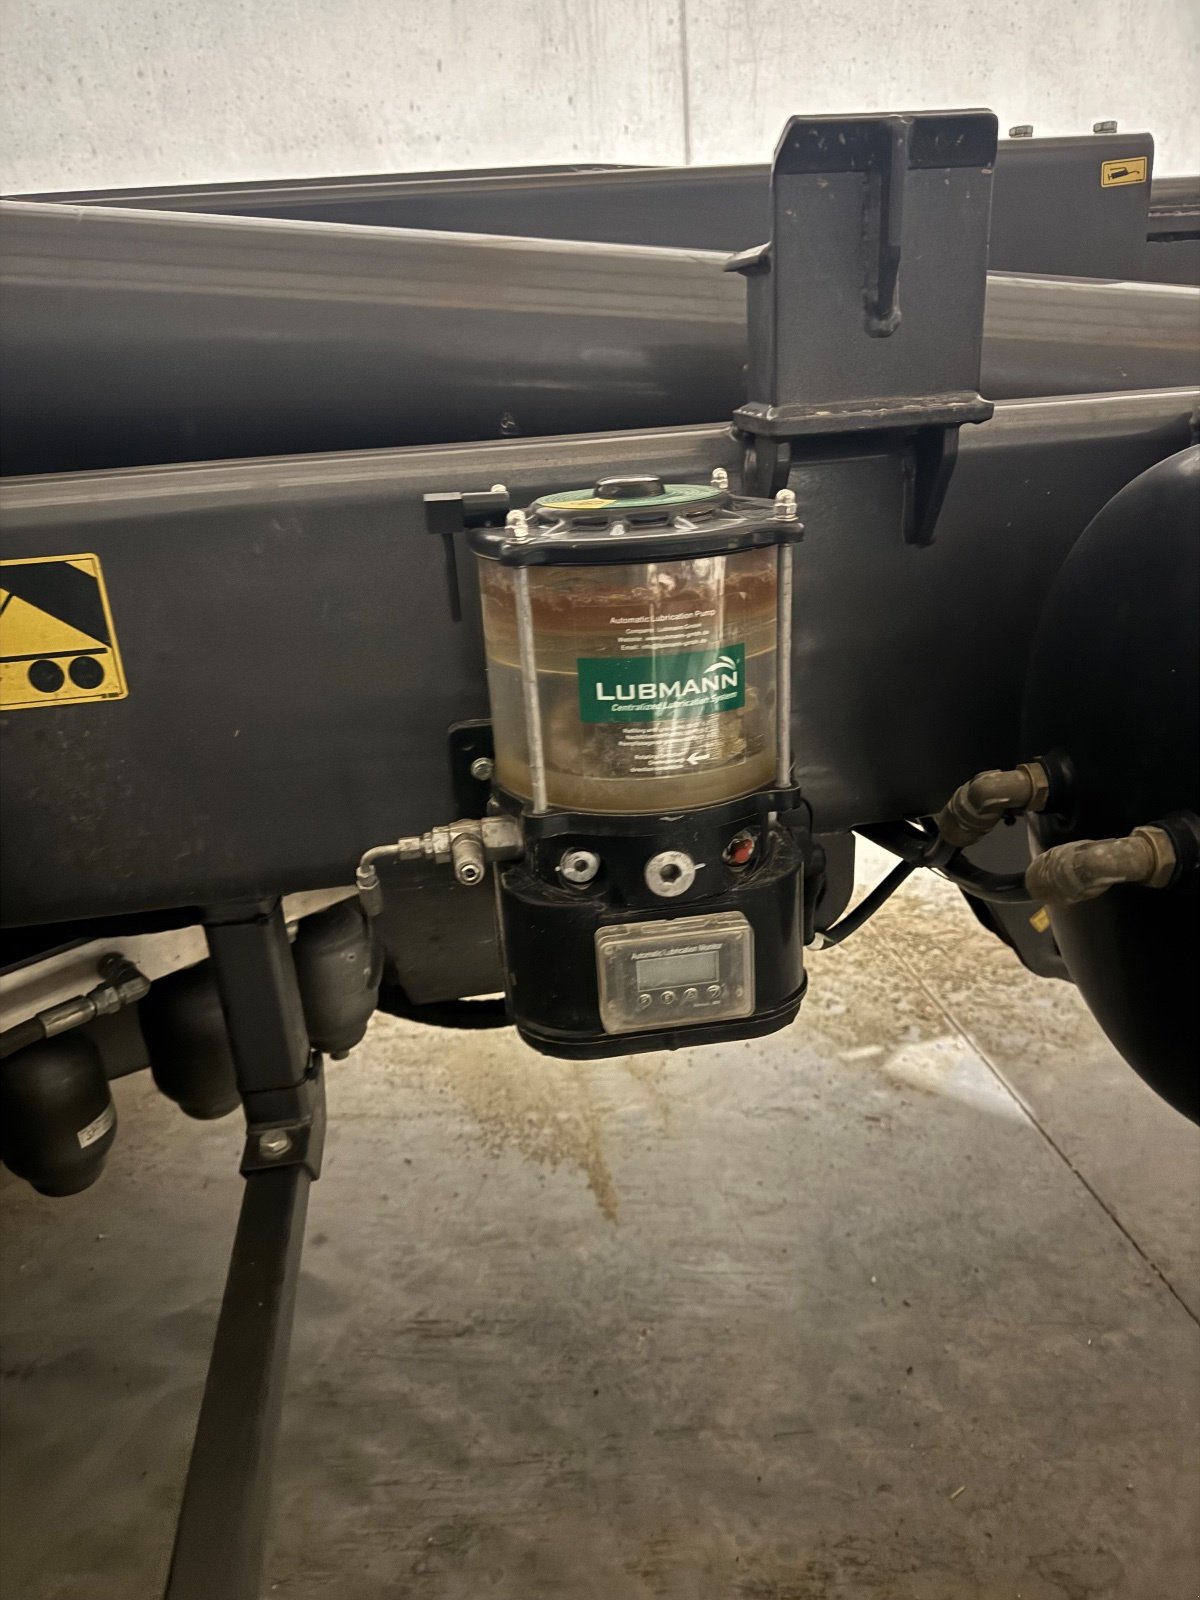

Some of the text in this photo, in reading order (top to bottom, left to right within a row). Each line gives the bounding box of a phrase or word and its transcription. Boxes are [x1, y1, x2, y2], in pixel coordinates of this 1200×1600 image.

[609, 609, 716, 624] Automatic Lubrication Pump
[596, 671, 738, 701] LUBMANN
[611, 702, 662, 712] Centralized
